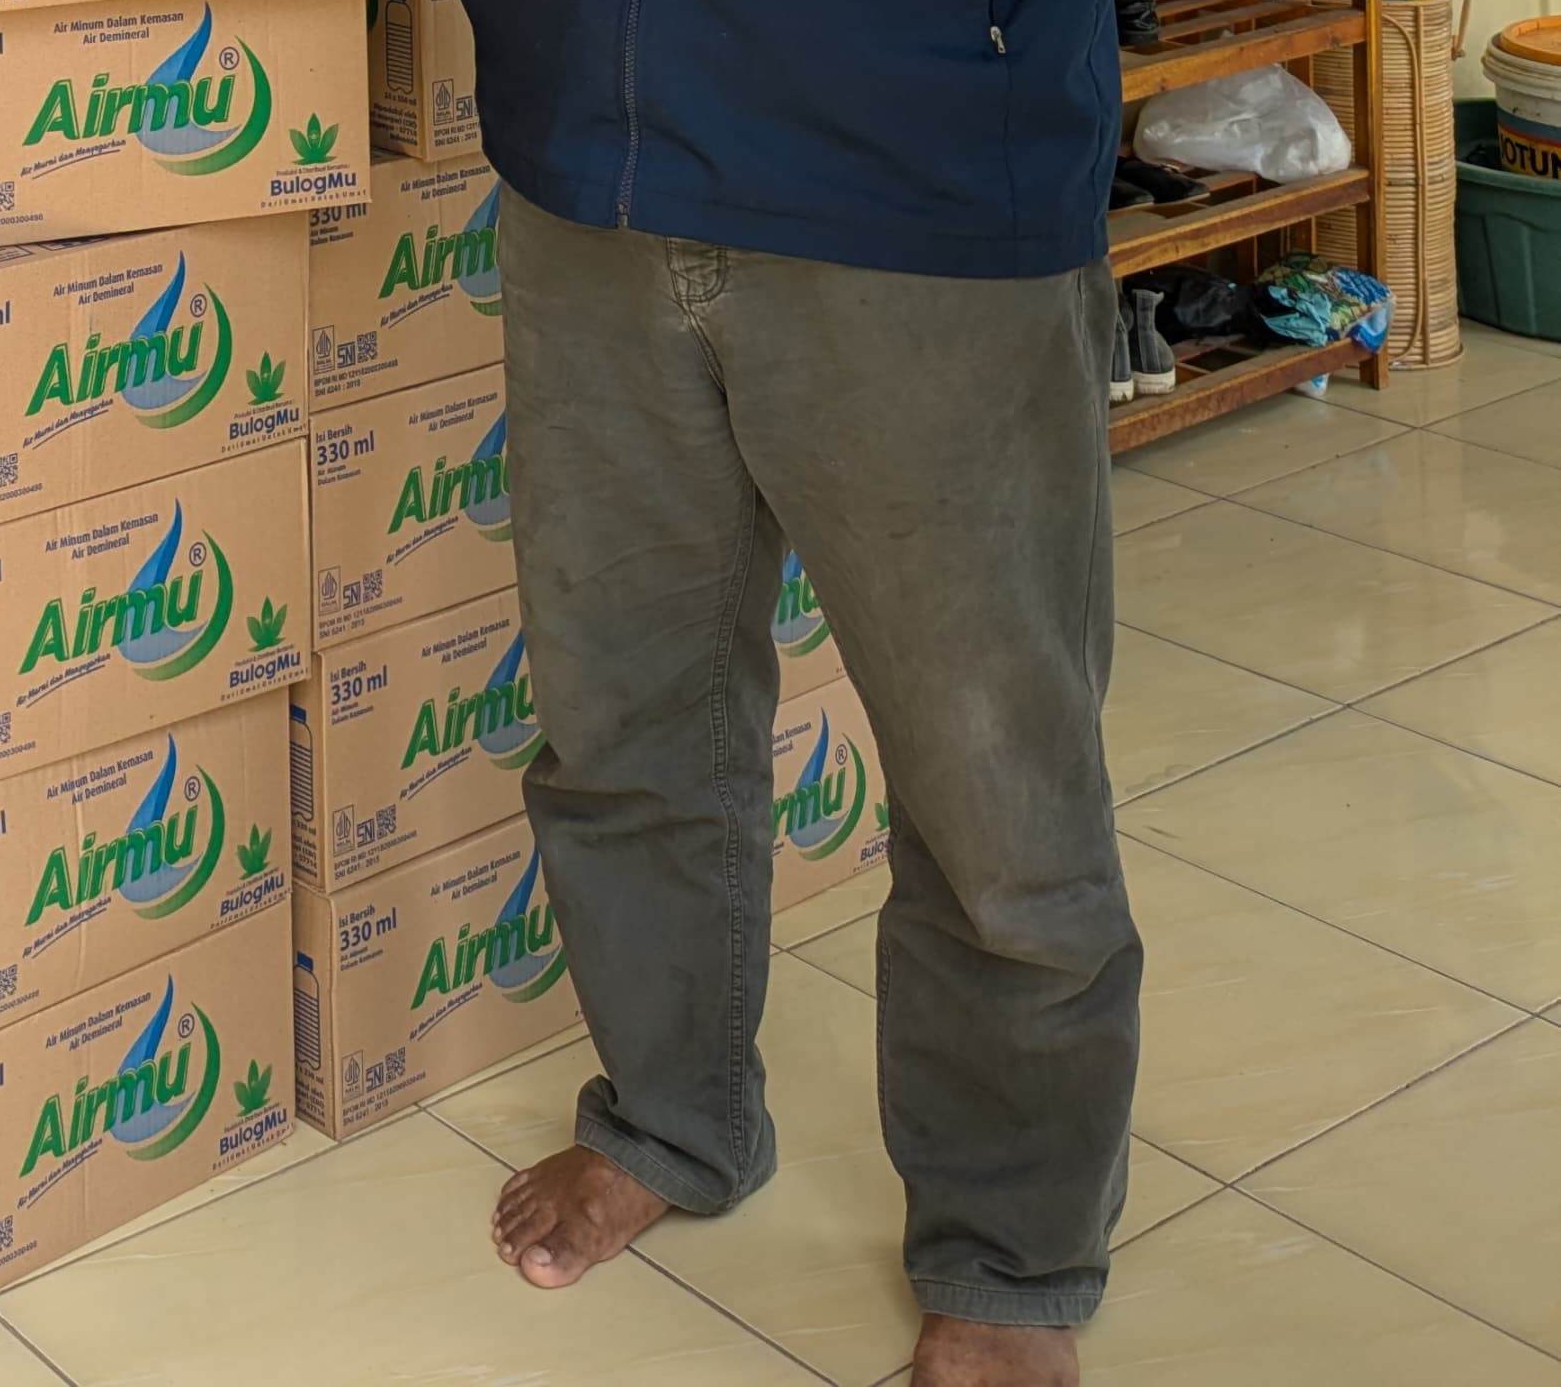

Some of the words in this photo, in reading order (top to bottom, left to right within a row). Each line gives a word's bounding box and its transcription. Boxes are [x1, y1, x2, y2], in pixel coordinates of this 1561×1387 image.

[53, 22, 67, 33] Air
[70, 19, 103, 31] Minum
[106, 15, 137, 28] Dalam
[140, 11, 183, 25] Kemasan
[83, 33, 95, 44] Air
[99, 27, 149, 42] Demineral
[22, 73, 235, 146] Airmu
[270, 172, 356, 196] BulogMu
[54, 284, 65, 296] Air
[68, 277, 96, 293] Minum
[98, 271, 124, 286] Dalam
[126, 262, 162, 280] Kemasan
[378, 223, 500, 299] Airm
[78, 293, 89, 305] Air
[92, 281, 134, 302] Demineral
[25, 322, 203, 416] Airmu
[230, 407, 298, 439] BulogMu
[317, 438, 349, 466] 330
[353, 429, 374, 455] ml
[46, 539, 57, 552] Air
[60, 531, 89, 548] Minum
[92, 522, 118, 539] Dalam
[121, 512, 158, 532] Kemasan
[71, 546, 82, 559] Air
[85, 533, 129, 555] Demineral
[18, 571, 203, 674] Airmu
[229, 652, 300, 687] BulogMu
[330, 675, 362, 705] 330
[366, 664, 387, 692] ml
[24, 804, 198, 926] Airmu
[220, 872, 285, 918] BulogMu
[339, 919, 371, 952] 330
[376, 906, 396, 936] ml
[410, 902, 554, 1010] Airmu
[45, 1033, 56, 1048] Air
[59, 1020, 86, 1042] Minum
[88, 1006, 112, 1028] Dalam
[115, 990, 150, 1015] Kemasan
[69, 1037, 80, 1051] Air
[82, 1015, 123, 1045] Demineral
[18, 1041, 190, 1176] Airmu
[219, 1108, 286, 1155] BulogMu
